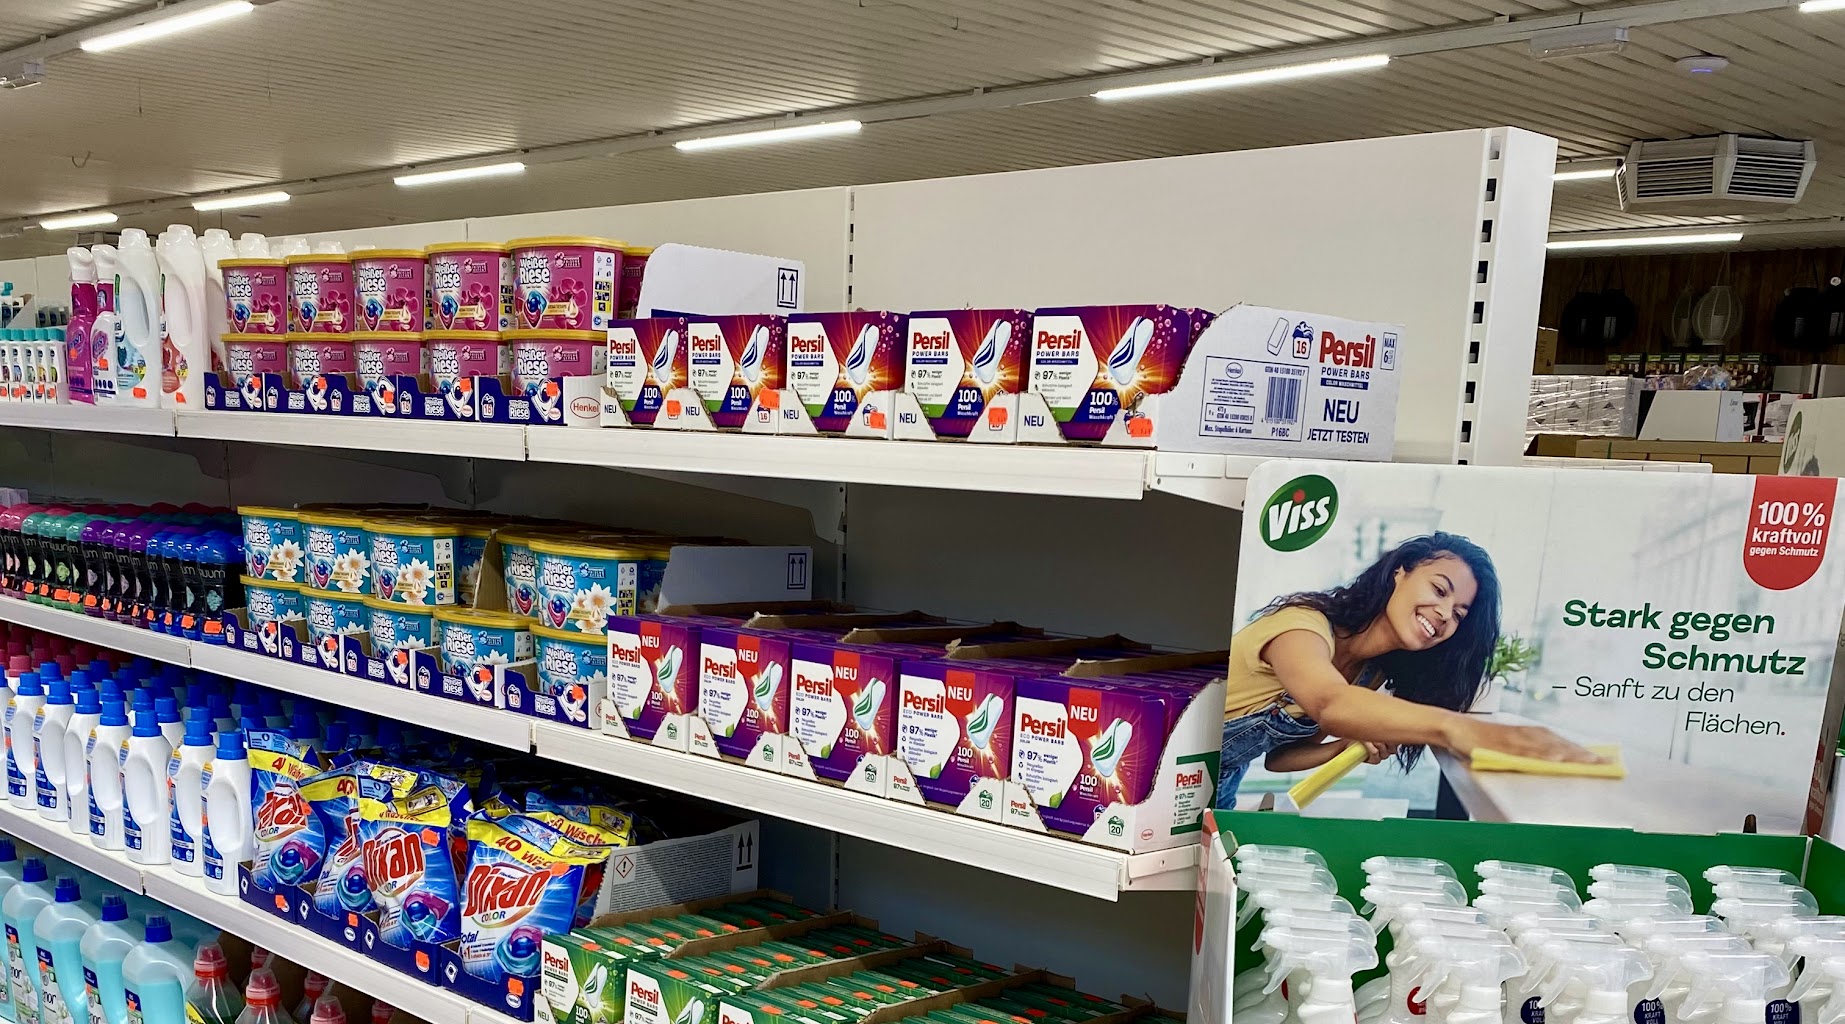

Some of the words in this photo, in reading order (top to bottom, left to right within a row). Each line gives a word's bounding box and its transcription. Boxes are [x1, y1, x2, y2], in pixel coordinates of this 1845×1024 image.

[520, 257, 548, 268] Weißer
[435, 273, 460, 288] Riese
[520, 267, 550, 284] Riese
[359, 278, 385, 291] Riese
[610, 338, 635, 354] Persil
[692, 336, 721, 351] Persil
[792, 335, 824, 352] Persil
[913, 331, 950, 350] Persil
[1037, 329, 1082, 349] Persil
[1296, 341, 1306, 354] 16
[1320, 331, 1376, 368] Persil
[1322, 367, 1348, 378] POWER
[1351, 369, 1370, 379] BARS
[573, 403, 599, 412] Henkel
[604, 405, 616, 414] NEU
[685, 406, 700, 416] NEU
[783, 409, 799, 419] NEU
[1324, 399, 1359, 423] NEU
[900, 413, 917, 423] NEU
[1024, 415, 1044, 426] NEU
[1308, 429, 1334, 441] JETZT
[1337, 431, 1369, 444] TESTEN
[1269, 489, 1330, 541] Viss
[1752, 527, 1823, 545] kraftvoll
[1750, 546, 1777, 556] gegen
[1779, 546, 1818, 556] Schmutz
[543, 561, 572, 575] Weißer
[544, 572, 575, 588] Riese
[1563, 600, 1663, 630] Stark
[1669, 610, 1775, 640] gegen
[642, 635, 659, 648] NEU
[612, 644, 640, 663] Persil
[738, 649, 758, 663] NEU
[1642, 643, 1806, 675] Schmutz
[705, 657, 736, 679] Persil
[836, 666, 857, 680] NEU
[796, 674, 832, 696] Persil
[1575, 676, 1645, 699] Sanft
[1652, 685, 1680, 700] zu
[1688, 682, 1734, 703] den
[903, 691, 944, 713] Persil
[947, 687, 972, 701] NEU
[1070, 706, 1098, 722] NEU
[1021, 713, 1066, 739] Persil
[1685, 711, 1785, 736] Flächen.
[1176, 770, 1203, 787] Persil
[1110, 825, 1121, 834] 20
[496, 836, 521, 852] 40
[481, 910, 506, 923] COLOR
[545, 952, 569, 973] Persil
[631, 981, 658, 1005] Persil
